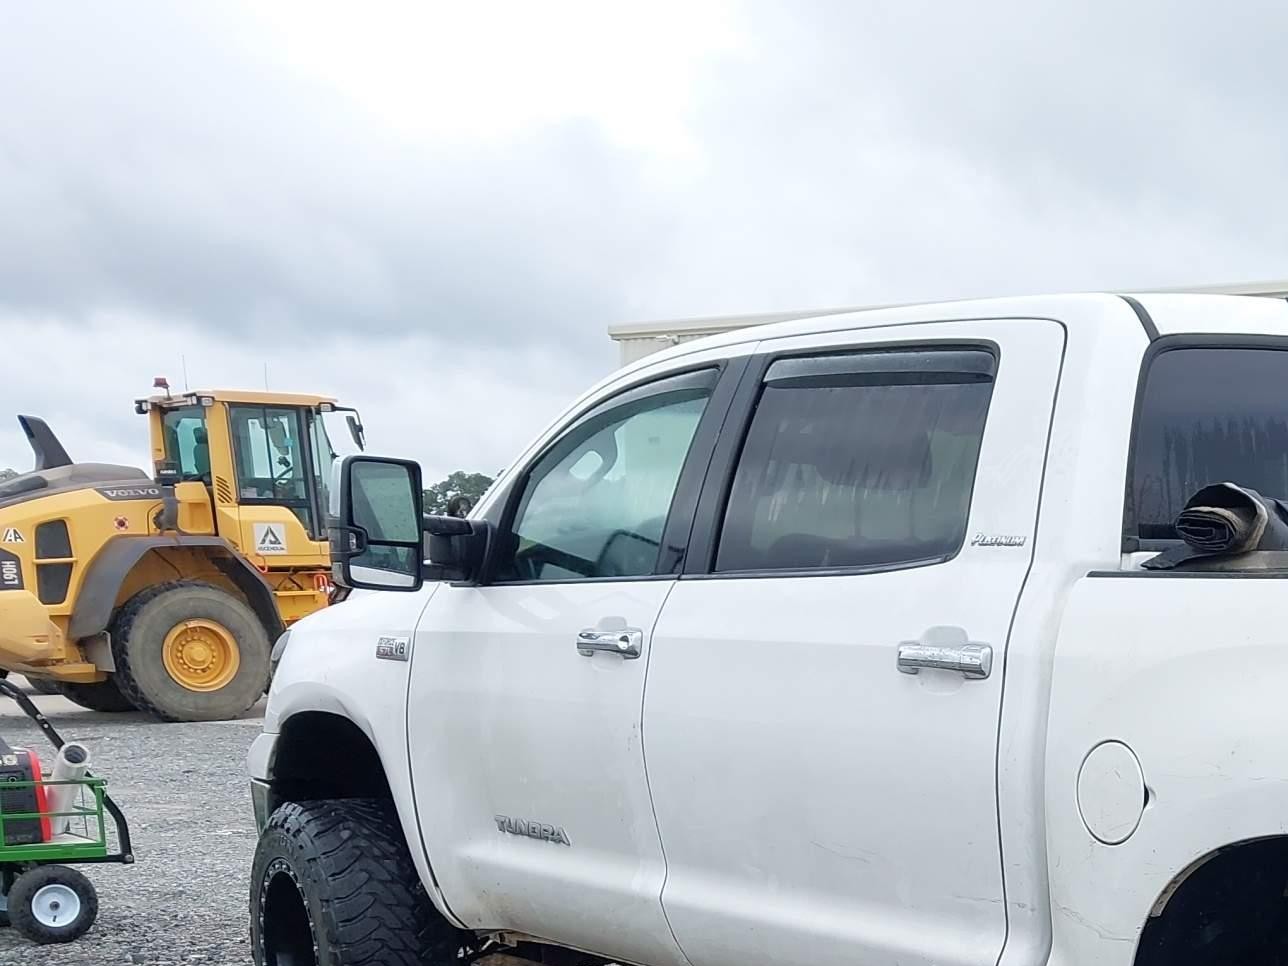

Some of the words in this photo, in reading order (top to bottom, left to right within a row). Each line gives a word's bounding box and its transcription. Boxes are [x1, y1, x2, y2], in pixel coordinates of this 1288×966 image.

[104, 488, 160, 498] VOLVO
[1, 560, 19, 585] L90H
[494, 814, 571, 847] TUNDRA
